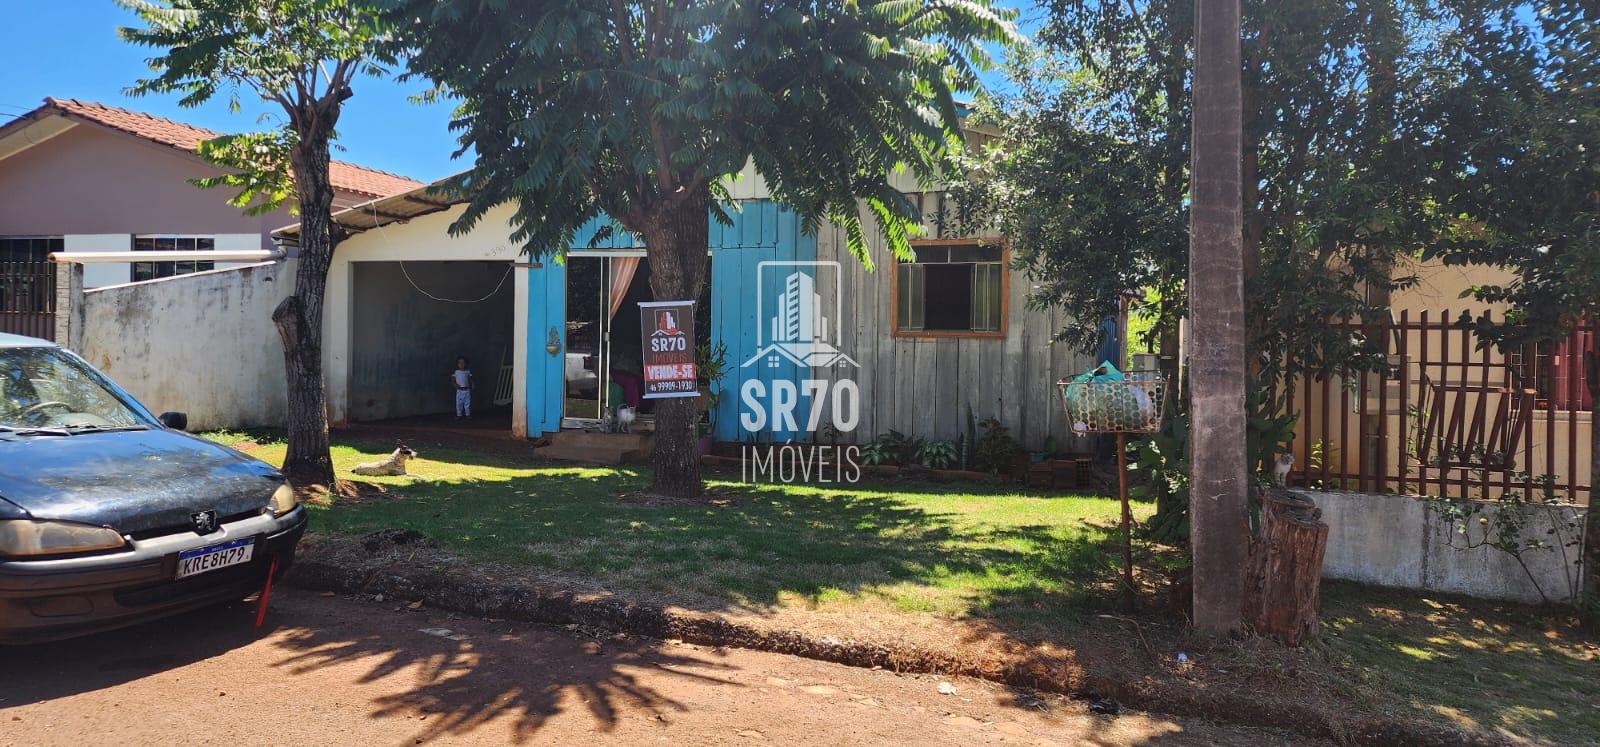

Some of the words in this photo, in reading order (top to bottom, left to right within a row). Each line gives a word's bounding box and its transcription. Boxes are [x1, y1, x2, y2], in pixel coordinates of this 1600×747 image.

[651, 337, 686, 352] SR70
[647, 364, 693, 380] VENDE-SE
[183, 547, 245, 575] KRE8H79
